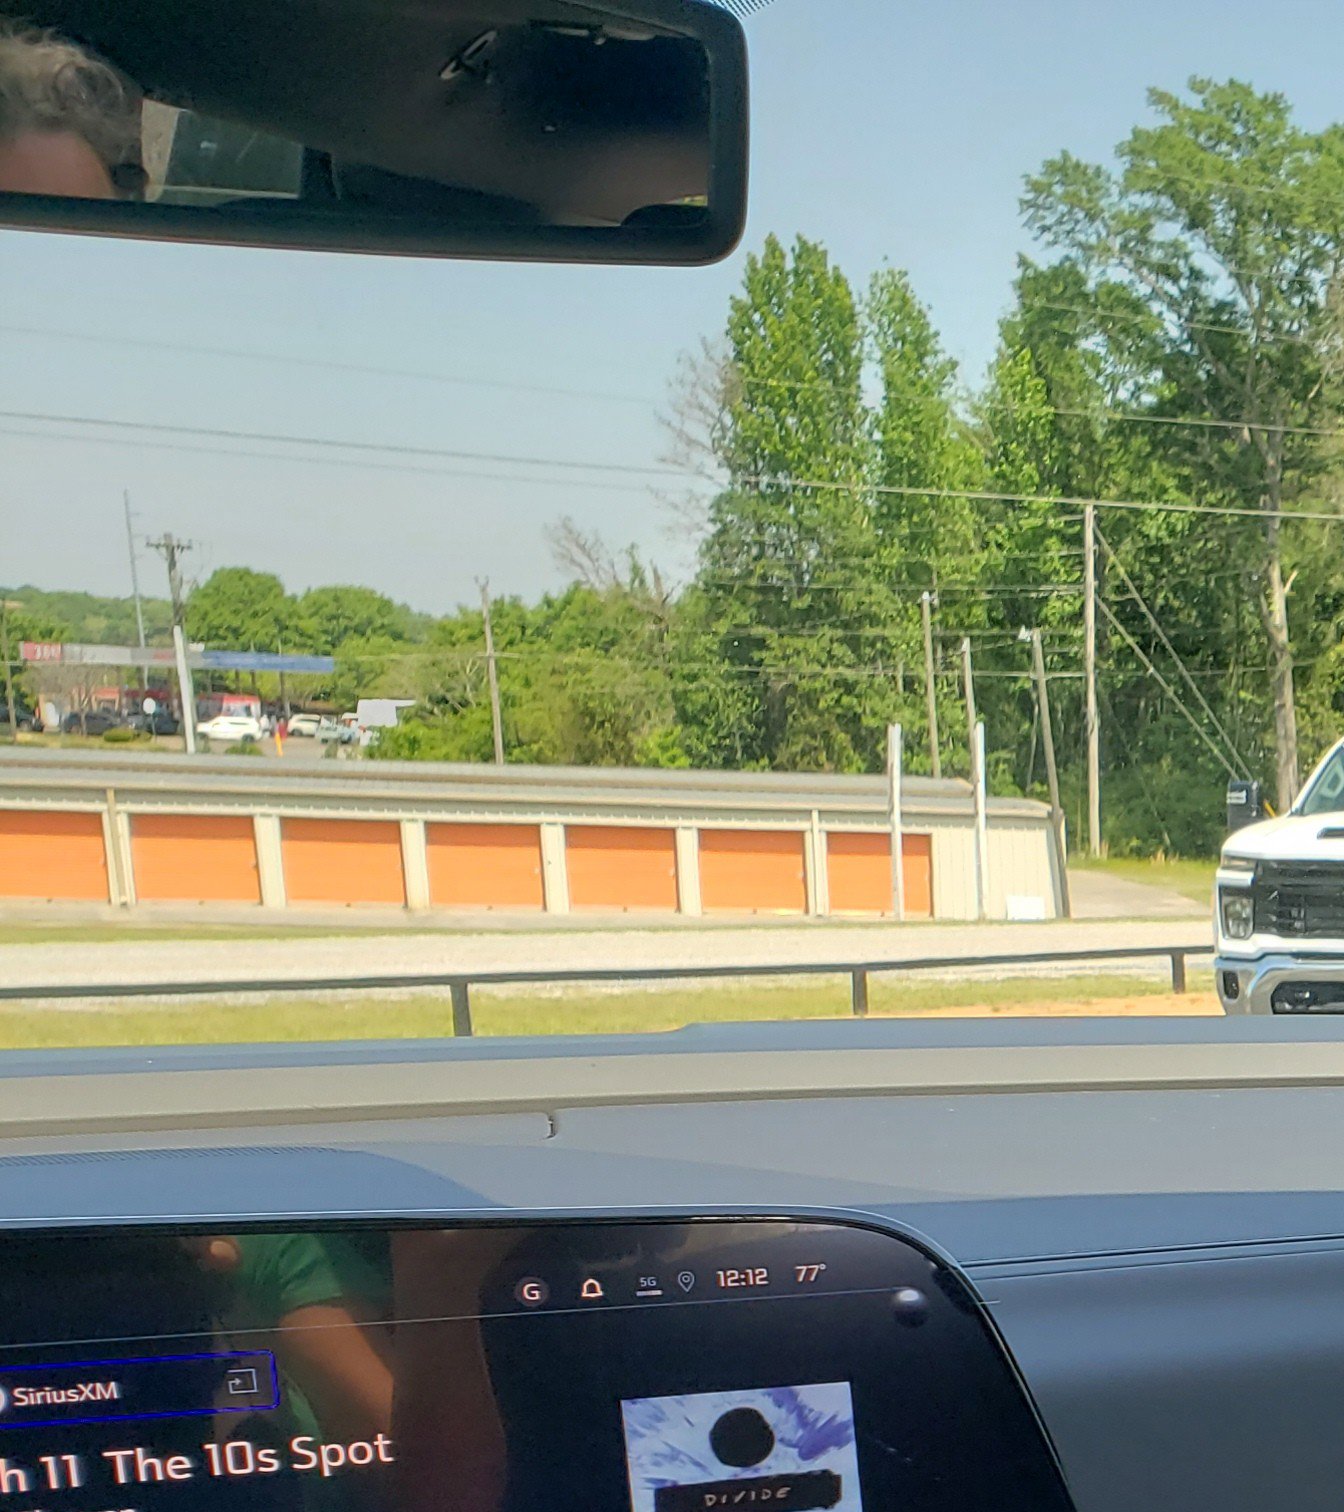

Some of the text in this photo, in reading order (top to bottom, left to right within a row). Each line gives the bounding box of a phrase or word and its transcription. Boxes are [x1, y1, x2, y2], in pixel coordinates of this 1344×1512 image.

[716, 1268, 770, 1288] 12:12
[12, 1381, 119, 1407] SiriusXM
[38, 1454, 80, 1489] 11
[102, 1447, 194, 1484] The
[202, 1440, 280, 1476] 10s
[290, 1433, 394, 1477] Spot
[704, 1486, 791, 1507] DIVIDE
